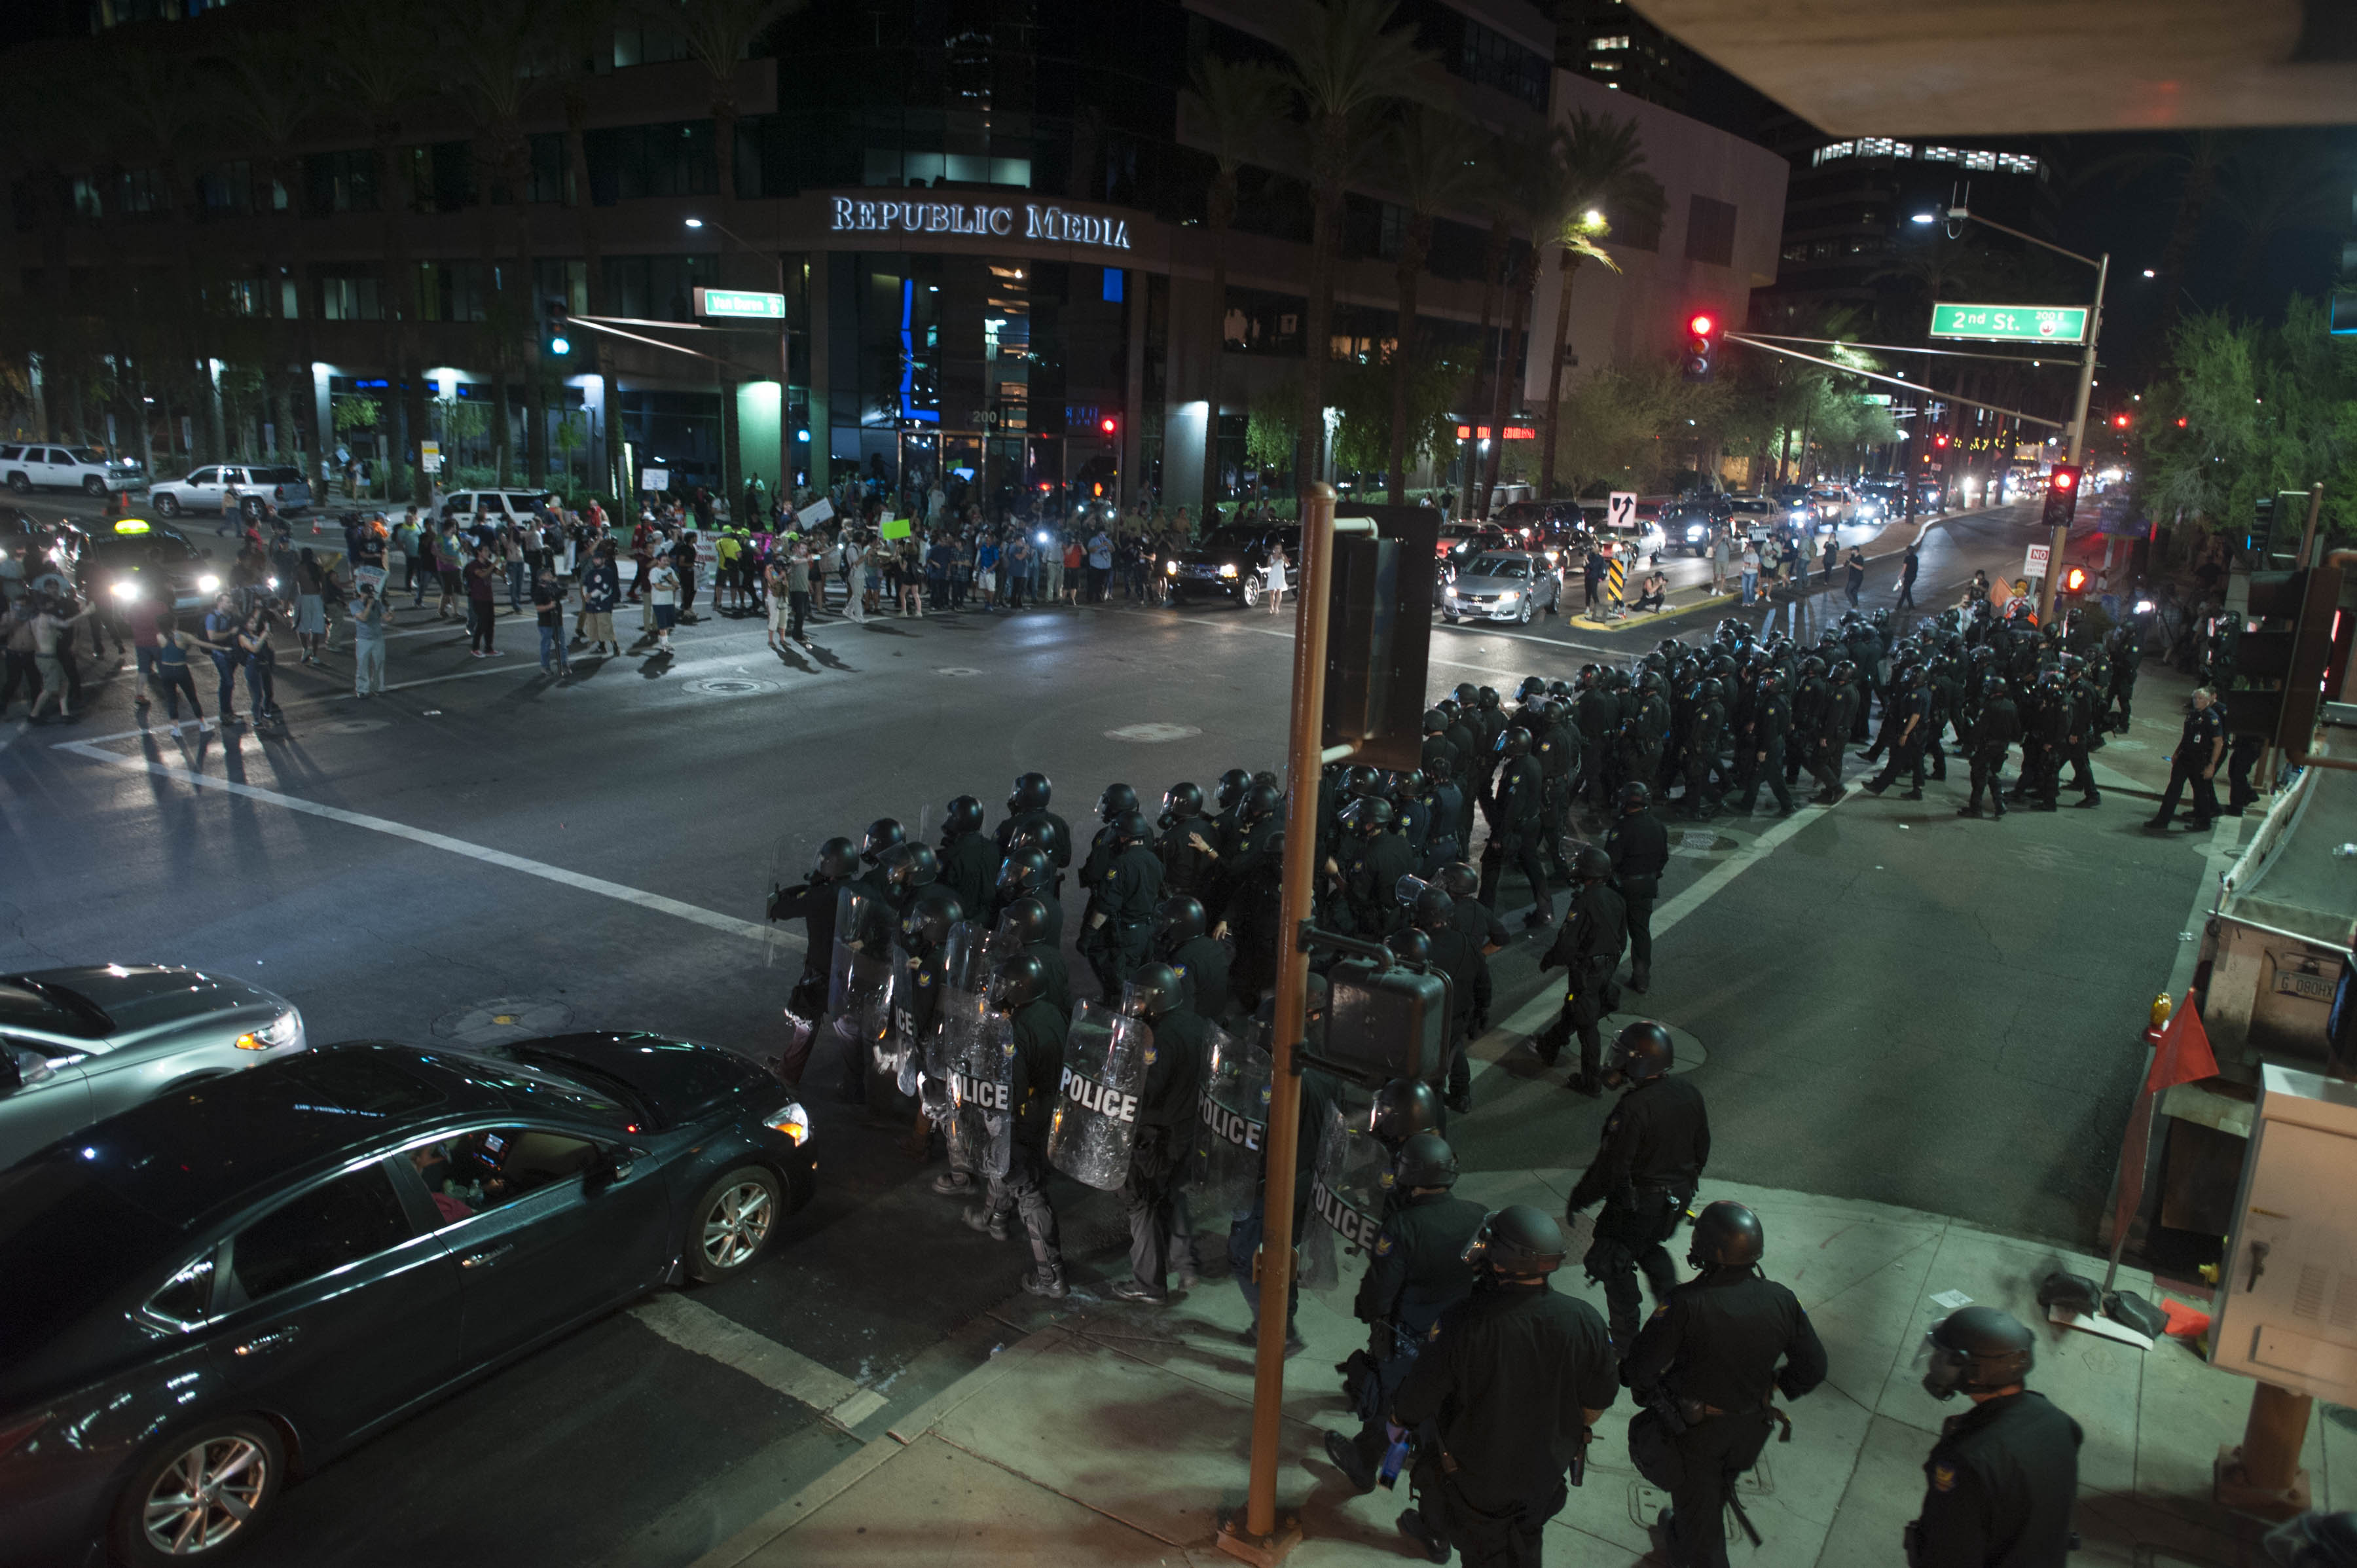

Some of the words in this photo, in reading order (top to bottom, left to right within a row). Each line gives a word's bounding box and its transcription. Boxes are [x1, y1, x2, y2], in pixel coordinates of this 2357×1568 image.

[831, 196, 1012, 236] REPUBLIC
[1026, 204, 1131, 248] MEDIA
[712, 295, 732, 310] Van
[2035, 311, 2055, 320] 200
[1952, 311, 1986, 329] 2nd
[1992, 313, 2020, 331] St.
[972, 410, 997, 424] 200
[2032, 550, 2047, 560] NO
[895, 1006, 913, 1036] ICE
[946, 1066, 1008, 1110] POLICE
[1059, 1066, 1139, 1123] POLICE
[1197, 1088, 1262, 1151] POLICE
[1311, 1170, 1376, 1250] POLICE
